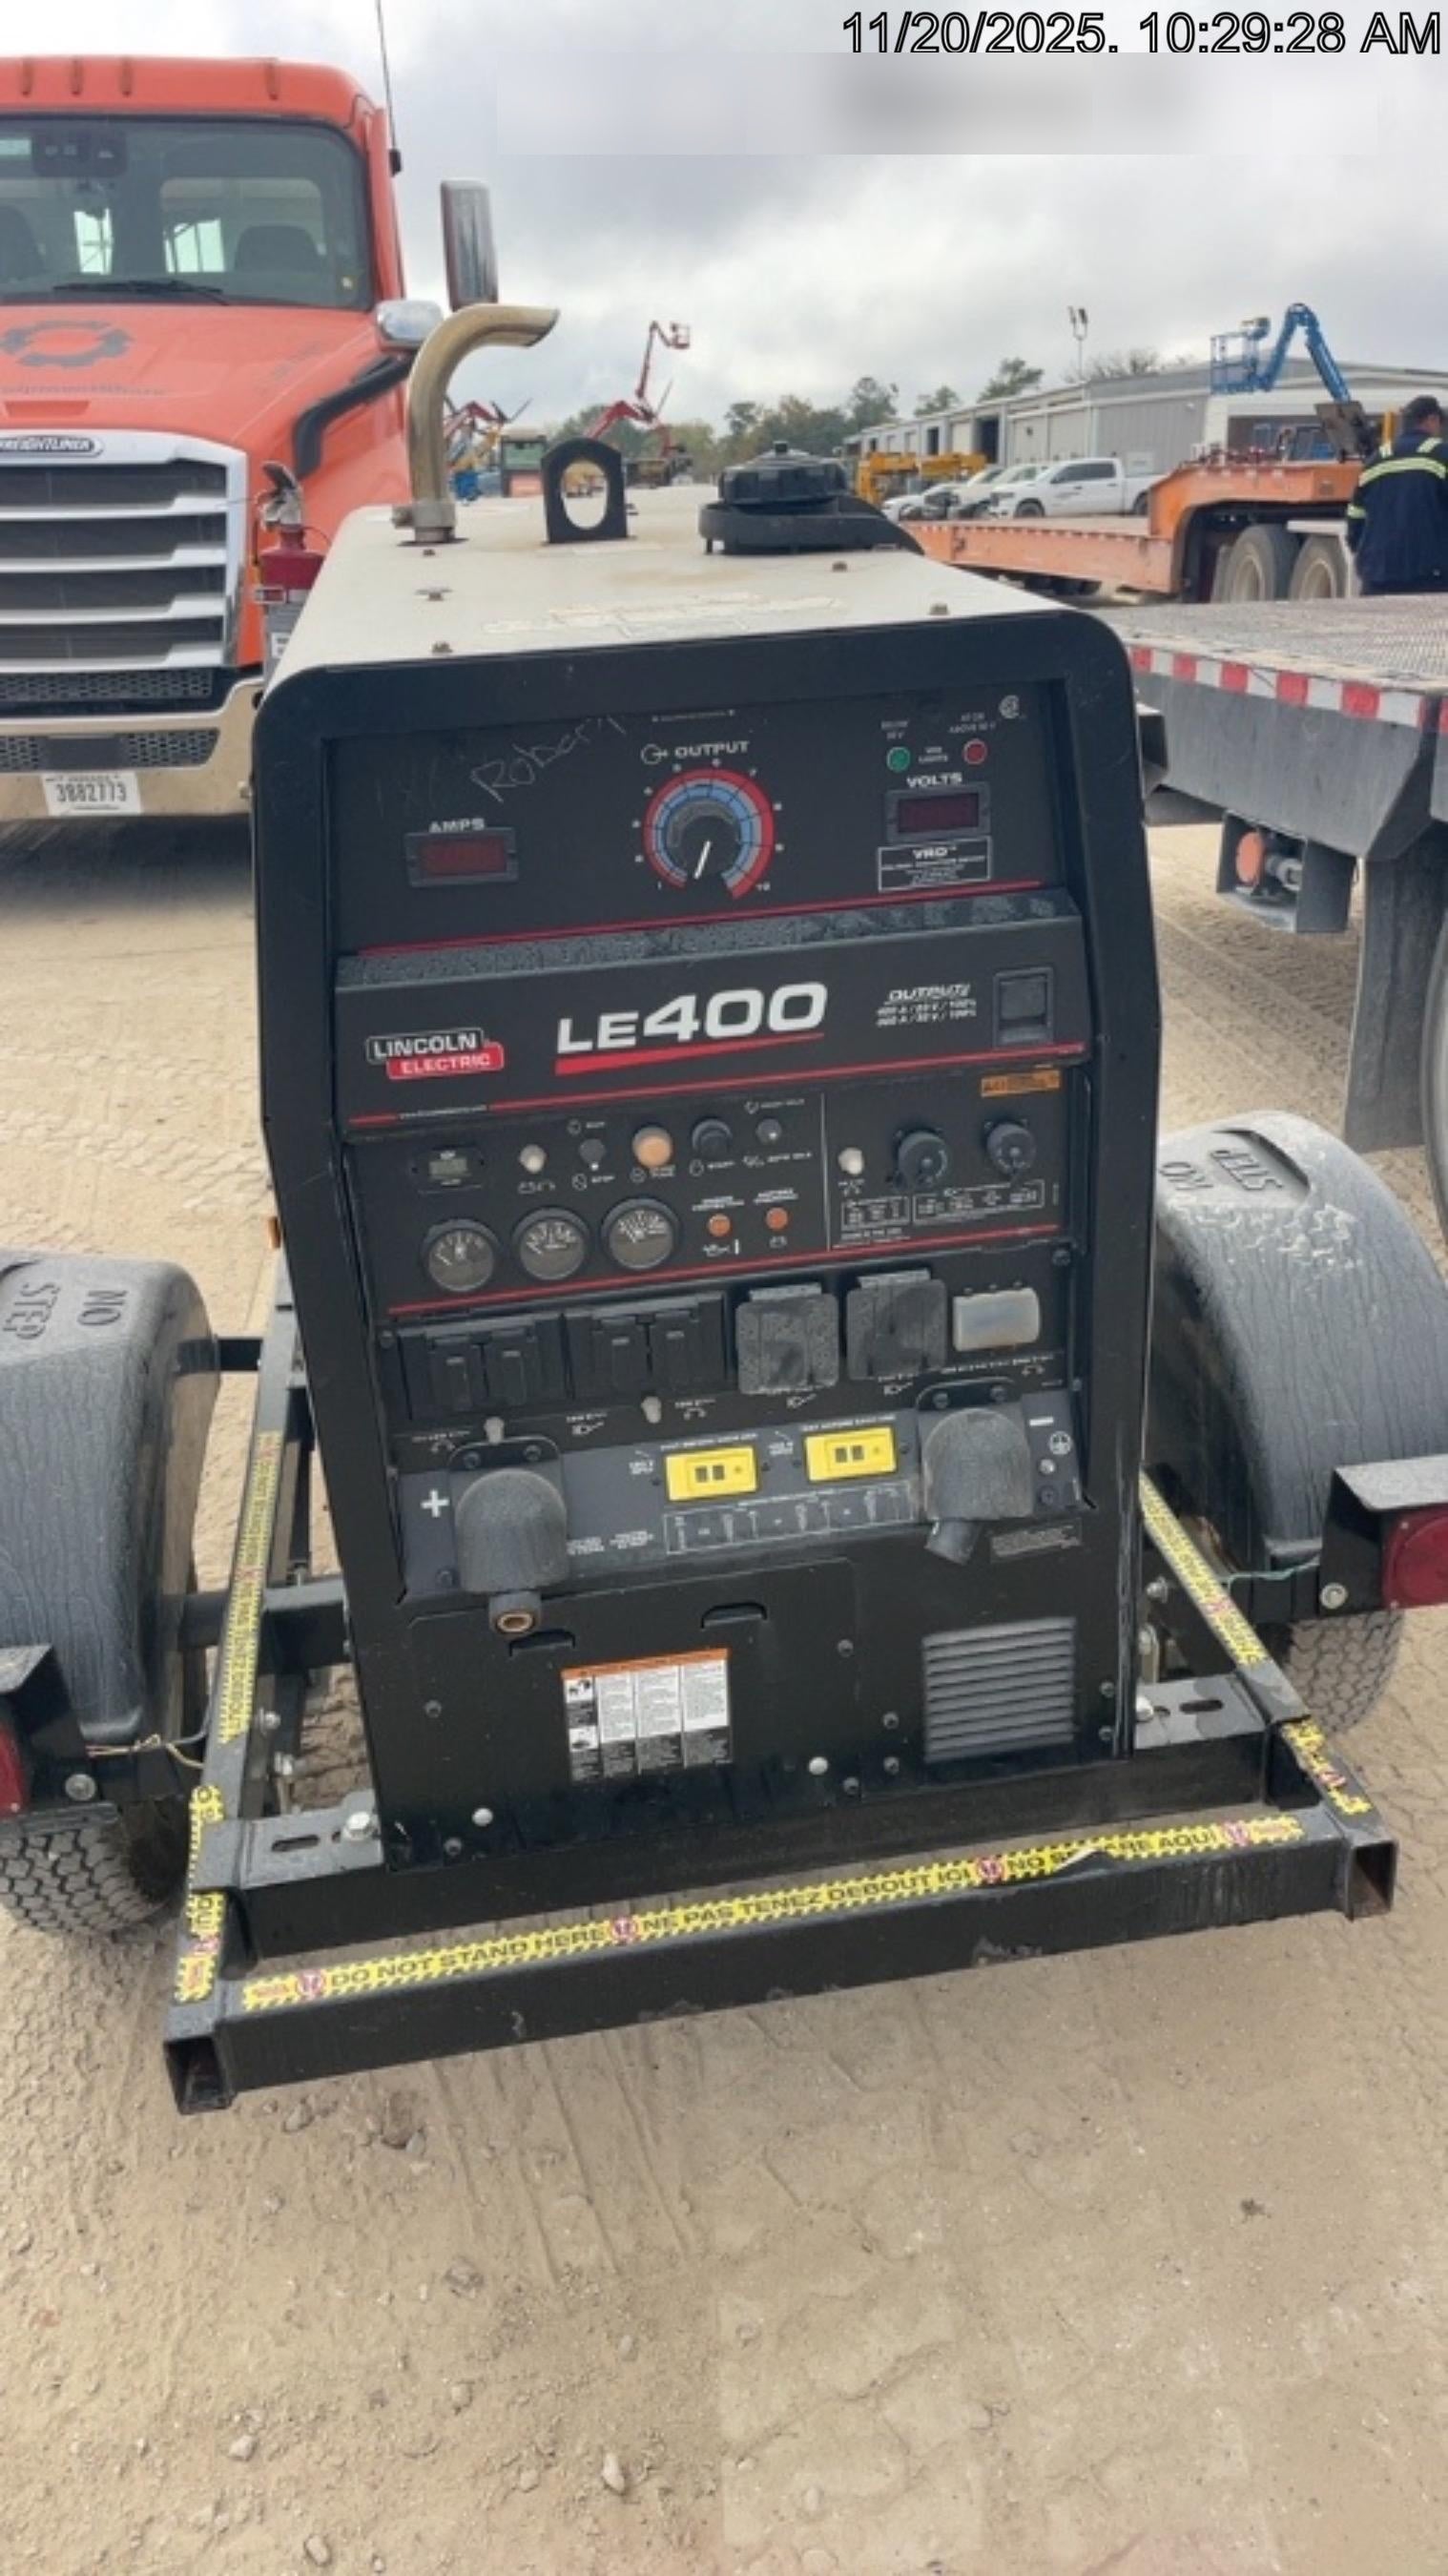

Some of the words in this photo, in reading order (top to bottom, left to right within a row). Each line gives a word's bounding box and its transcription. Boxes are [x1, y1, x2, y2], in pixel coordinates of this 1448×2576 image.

[674, 740, 750, 759] OUTPUT
[906, 772, 962, 789] VOLTS
[428, 817, 486, 834] AMPS
[555, 982, 828, 1054] LE400
[372, 1031, 478, 1059] LINCOLN
[401, 1052, 491, 1075] ELECTRIC
[2, 1282, 61, 1340] STEP
[76, 1290, 128, 1326] NO
[1007, 1857, 1046, 1873] NO
[642, 1916, 678, 1933] NE
[684, 1906, 734, 1925] PAS
[742, 1890, 824, 1914] TENEZ
[827, 1875, 930, 1901] DEBOUT
[331, 1966, 370, 1987] DO
[377, 1956, 434, 1979] NOT
[440, 1941, 527, 1969] STAND
[534, 1928, 605, 1951] HERE
